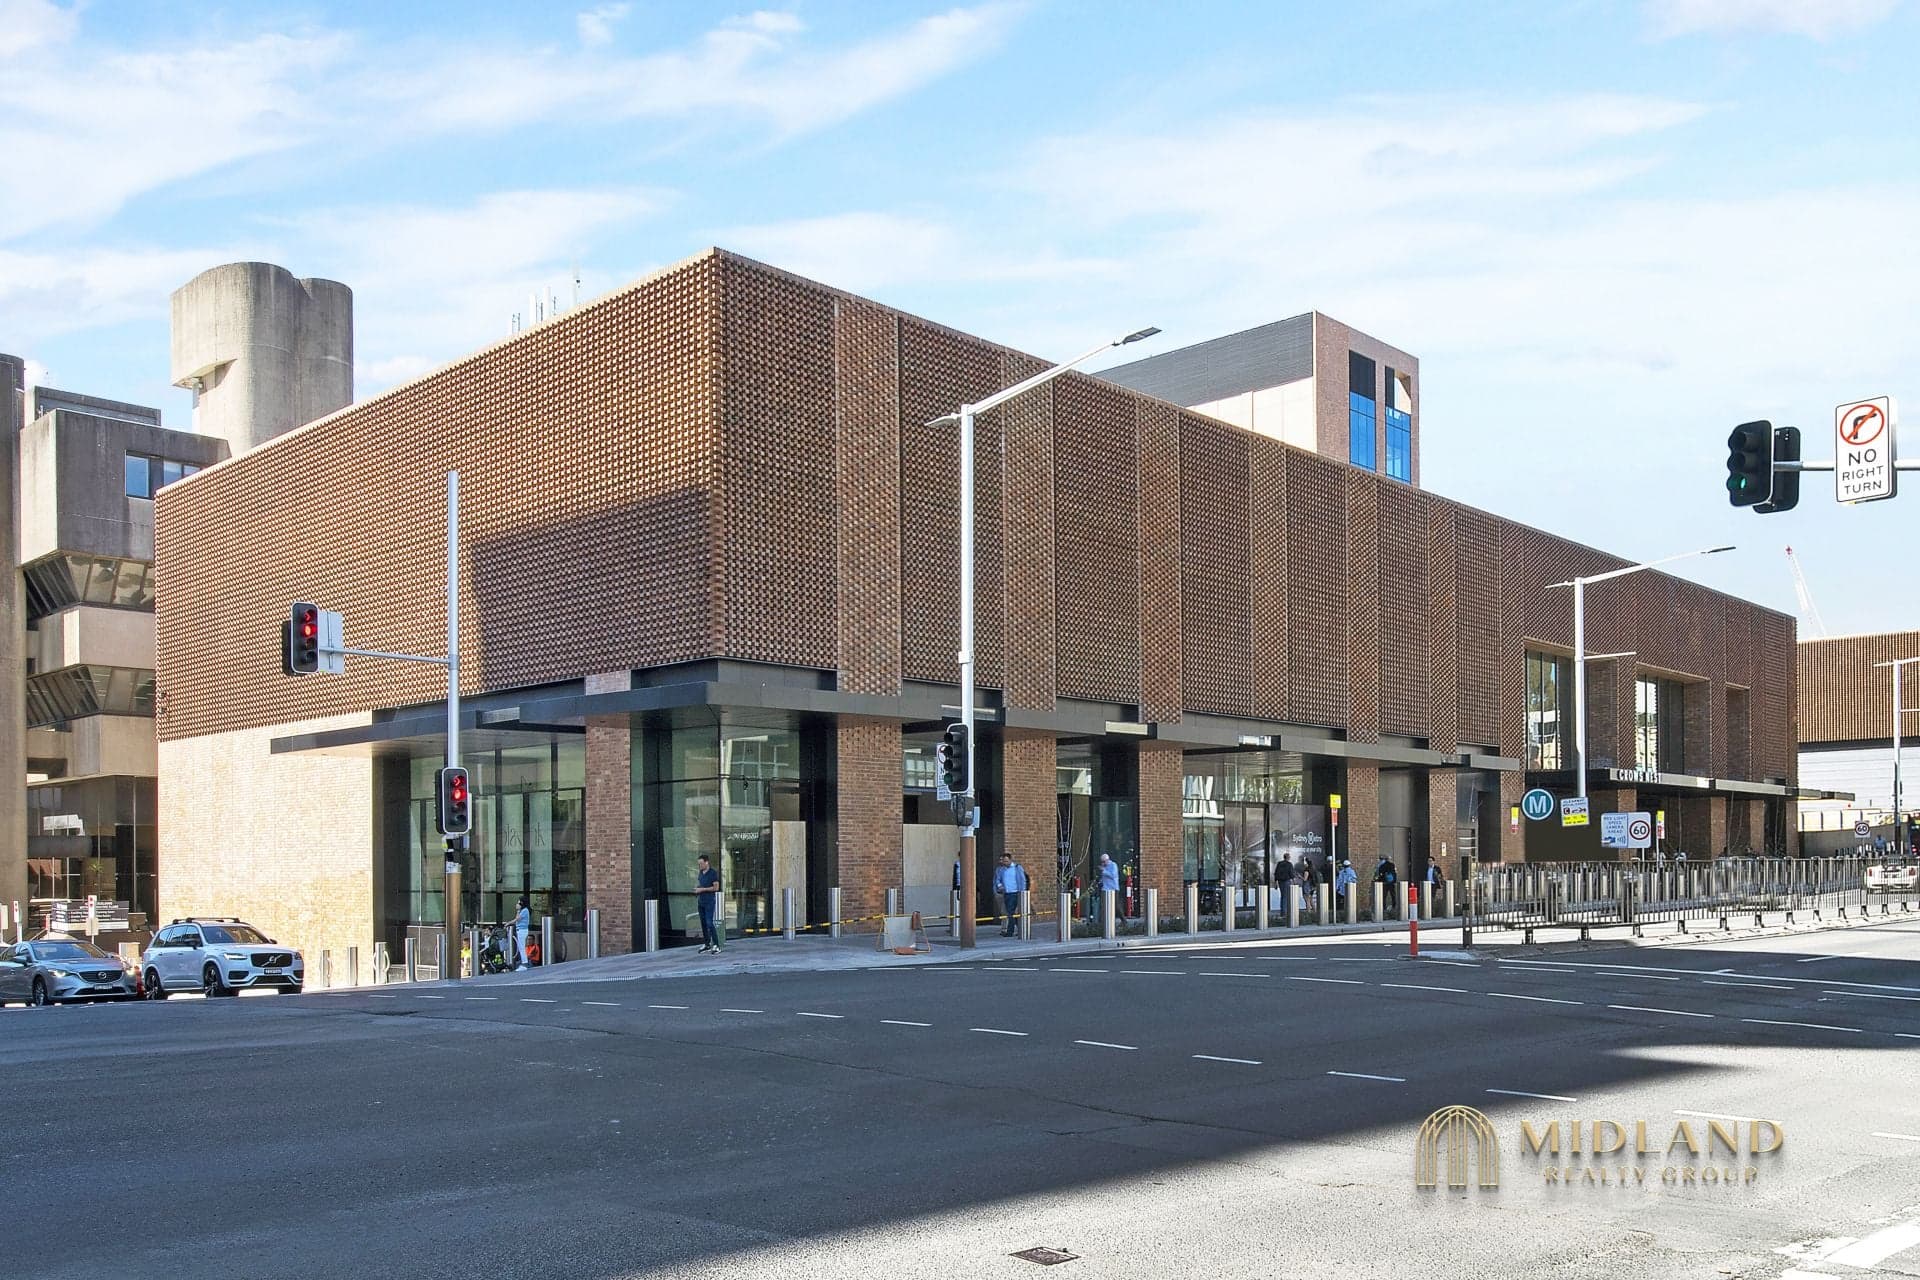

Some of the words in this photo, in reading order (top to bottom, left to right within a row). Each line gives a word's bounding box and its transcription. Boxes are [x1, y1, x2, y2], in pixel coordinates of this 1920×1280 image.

[1848, 448, 1877, 466] NO
[1842, 465, 1884, 481] RIGHT
[1844, 480, 1882, 495] TURN
[1619, 769, 1643, 782] CROWS
[1645, 771, 1662, 784] NEST
[1529, 795, 1547, 814] M
[1633, 825, 1647, 835] 60
